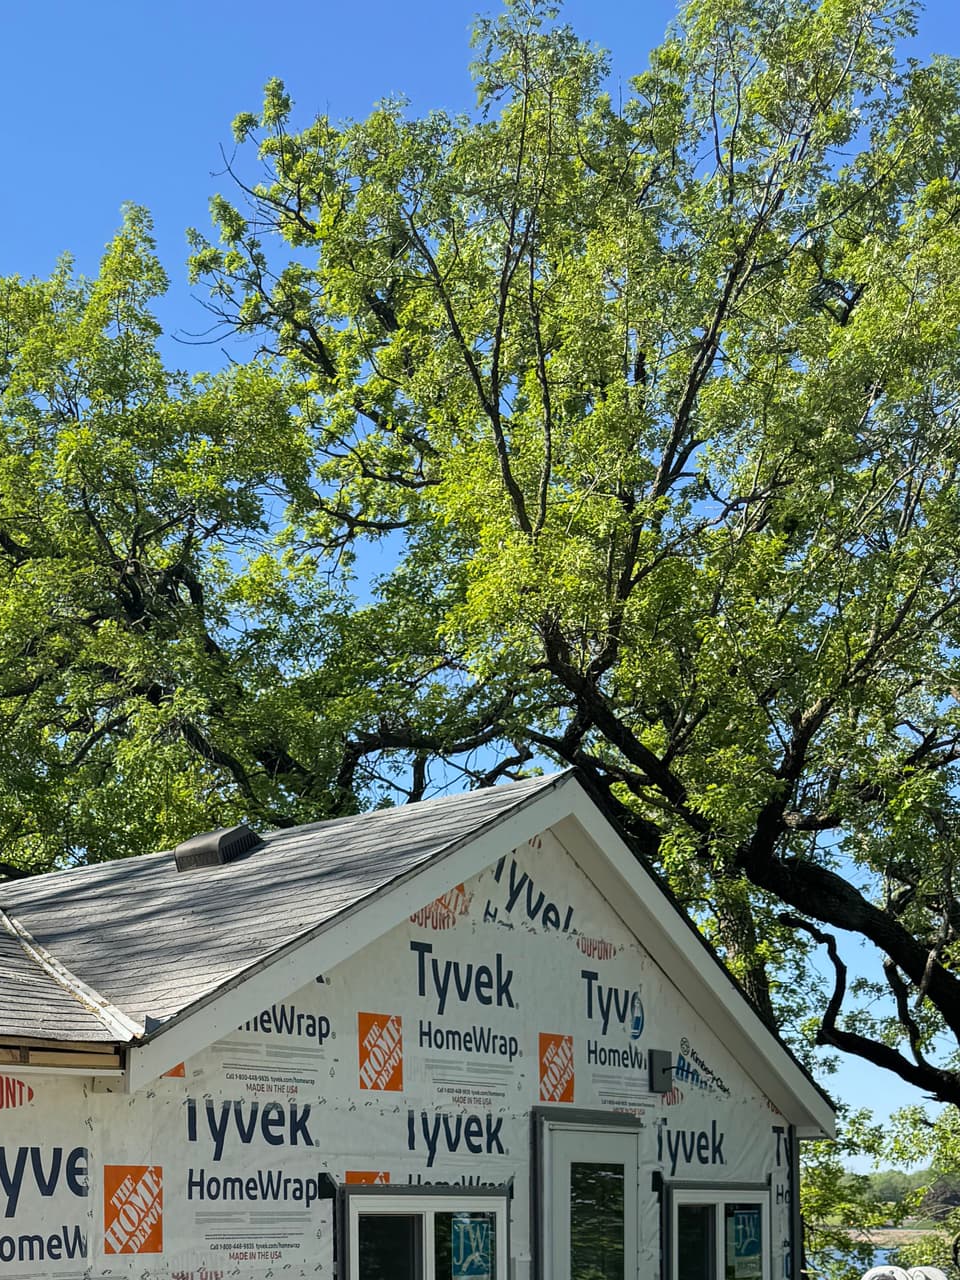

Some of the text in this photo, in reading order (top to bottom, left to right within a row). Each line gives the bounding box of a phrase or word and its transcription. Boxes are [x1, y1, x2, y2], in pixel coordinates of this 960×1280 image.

[410, 940, 515, 1016] Tyvek
[359, 1014, 402, 1090] HOME
[362, 1021, 382, 1050] THE
[418, 1020, 518, 1062] HomeWrap
[246, 1083, 265, 1093] MADE
[274, 1084, 286, 1094] THE
[286, 1085, 298, 1095] USA
[375, 1044, 403, 1091] DEPOT
[655, 1118, 724, 1176] Tyvek
[104, 1166, 163, 1254] HOME
[110, 1174, 136, 1212] THE
[187, 1168, 318, 1208] HomeWrap
[126, 1200, 164, 1255] DEPOT
[229, 1251, 248, 1261] MADE
[257, 1250, 269, 1260] THE
[270, 1250, 282, 1259] USA
